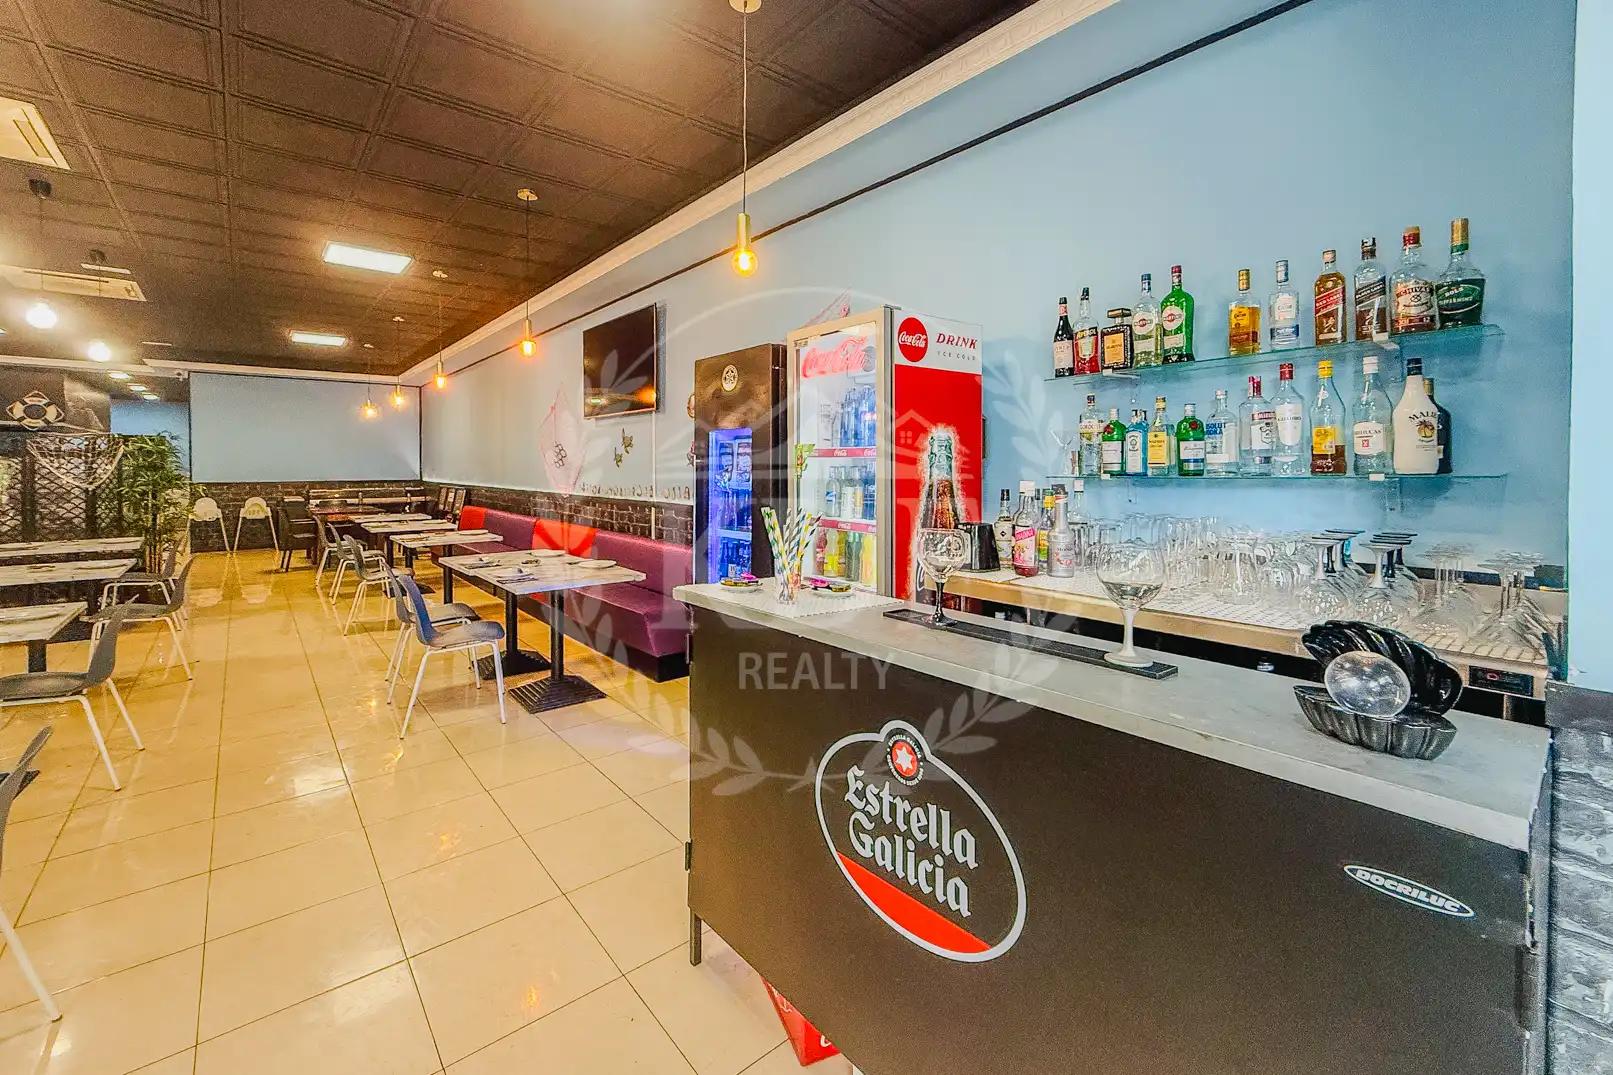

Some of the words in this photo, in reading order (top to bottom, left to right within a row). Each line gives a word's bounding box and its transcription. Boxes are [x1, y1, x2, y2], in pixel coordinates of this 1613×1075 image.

[936, 332, 978, 349] DRINK
[937, 350, 952, 358] ICE
[956, 353, 976, 361] COLD
[844, 765, 979, 870] Estrella
[849, 811, 971, 918] Galicia
[1355, 869, 1461, 912] DOCRILUC
